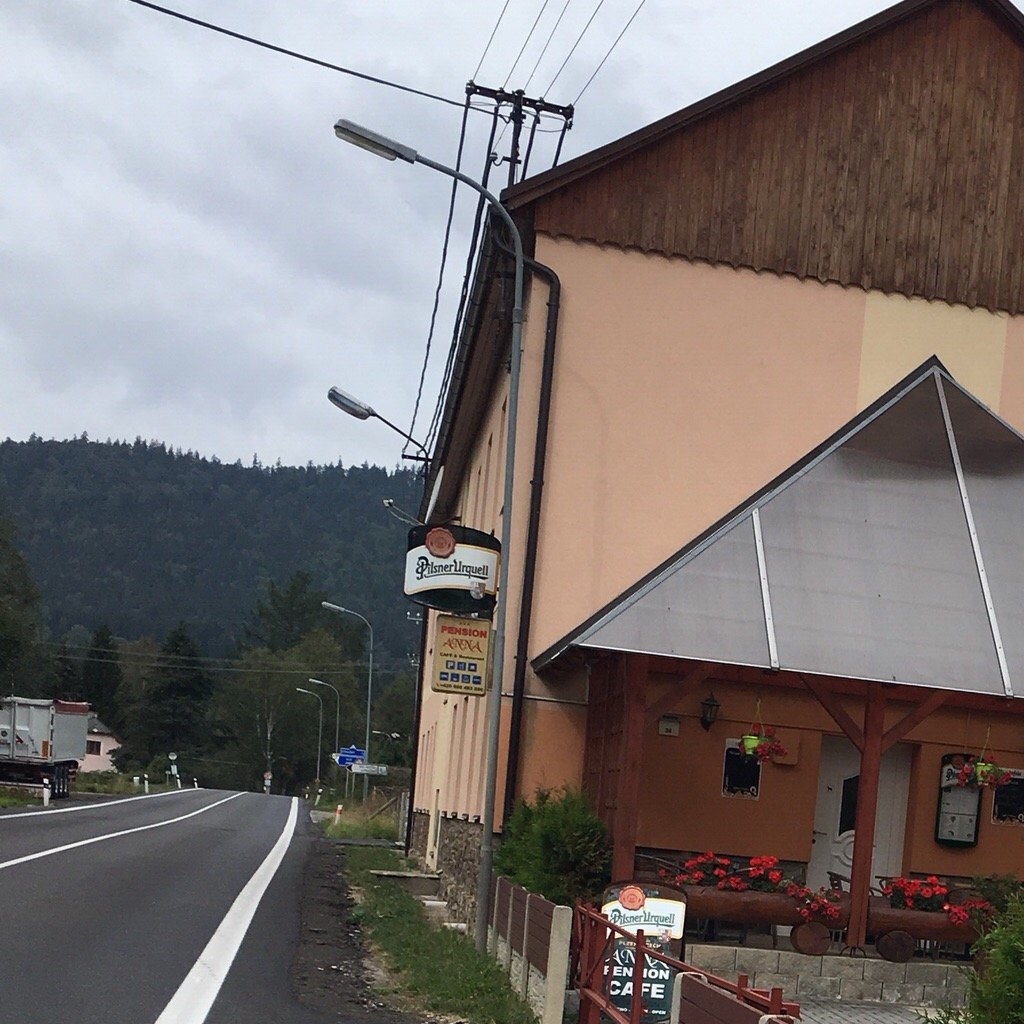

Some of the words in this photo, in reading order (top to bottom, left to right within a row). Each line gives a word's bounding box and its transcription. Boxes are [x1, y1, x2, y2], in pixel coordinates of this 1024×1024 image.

[415, 555, 454, 580] Pilsner
[453, 559, 489, 579] Urquell
[440, 625, 487, 638] PENSION
[442, 637, 482, 653] ANNA
[609, 908, 644, 926] Pilsner
[642, 910, 676, 928] Urquell
[603, 965, 670, 981] PENION
[609, 980, 666, 999] CAFE
